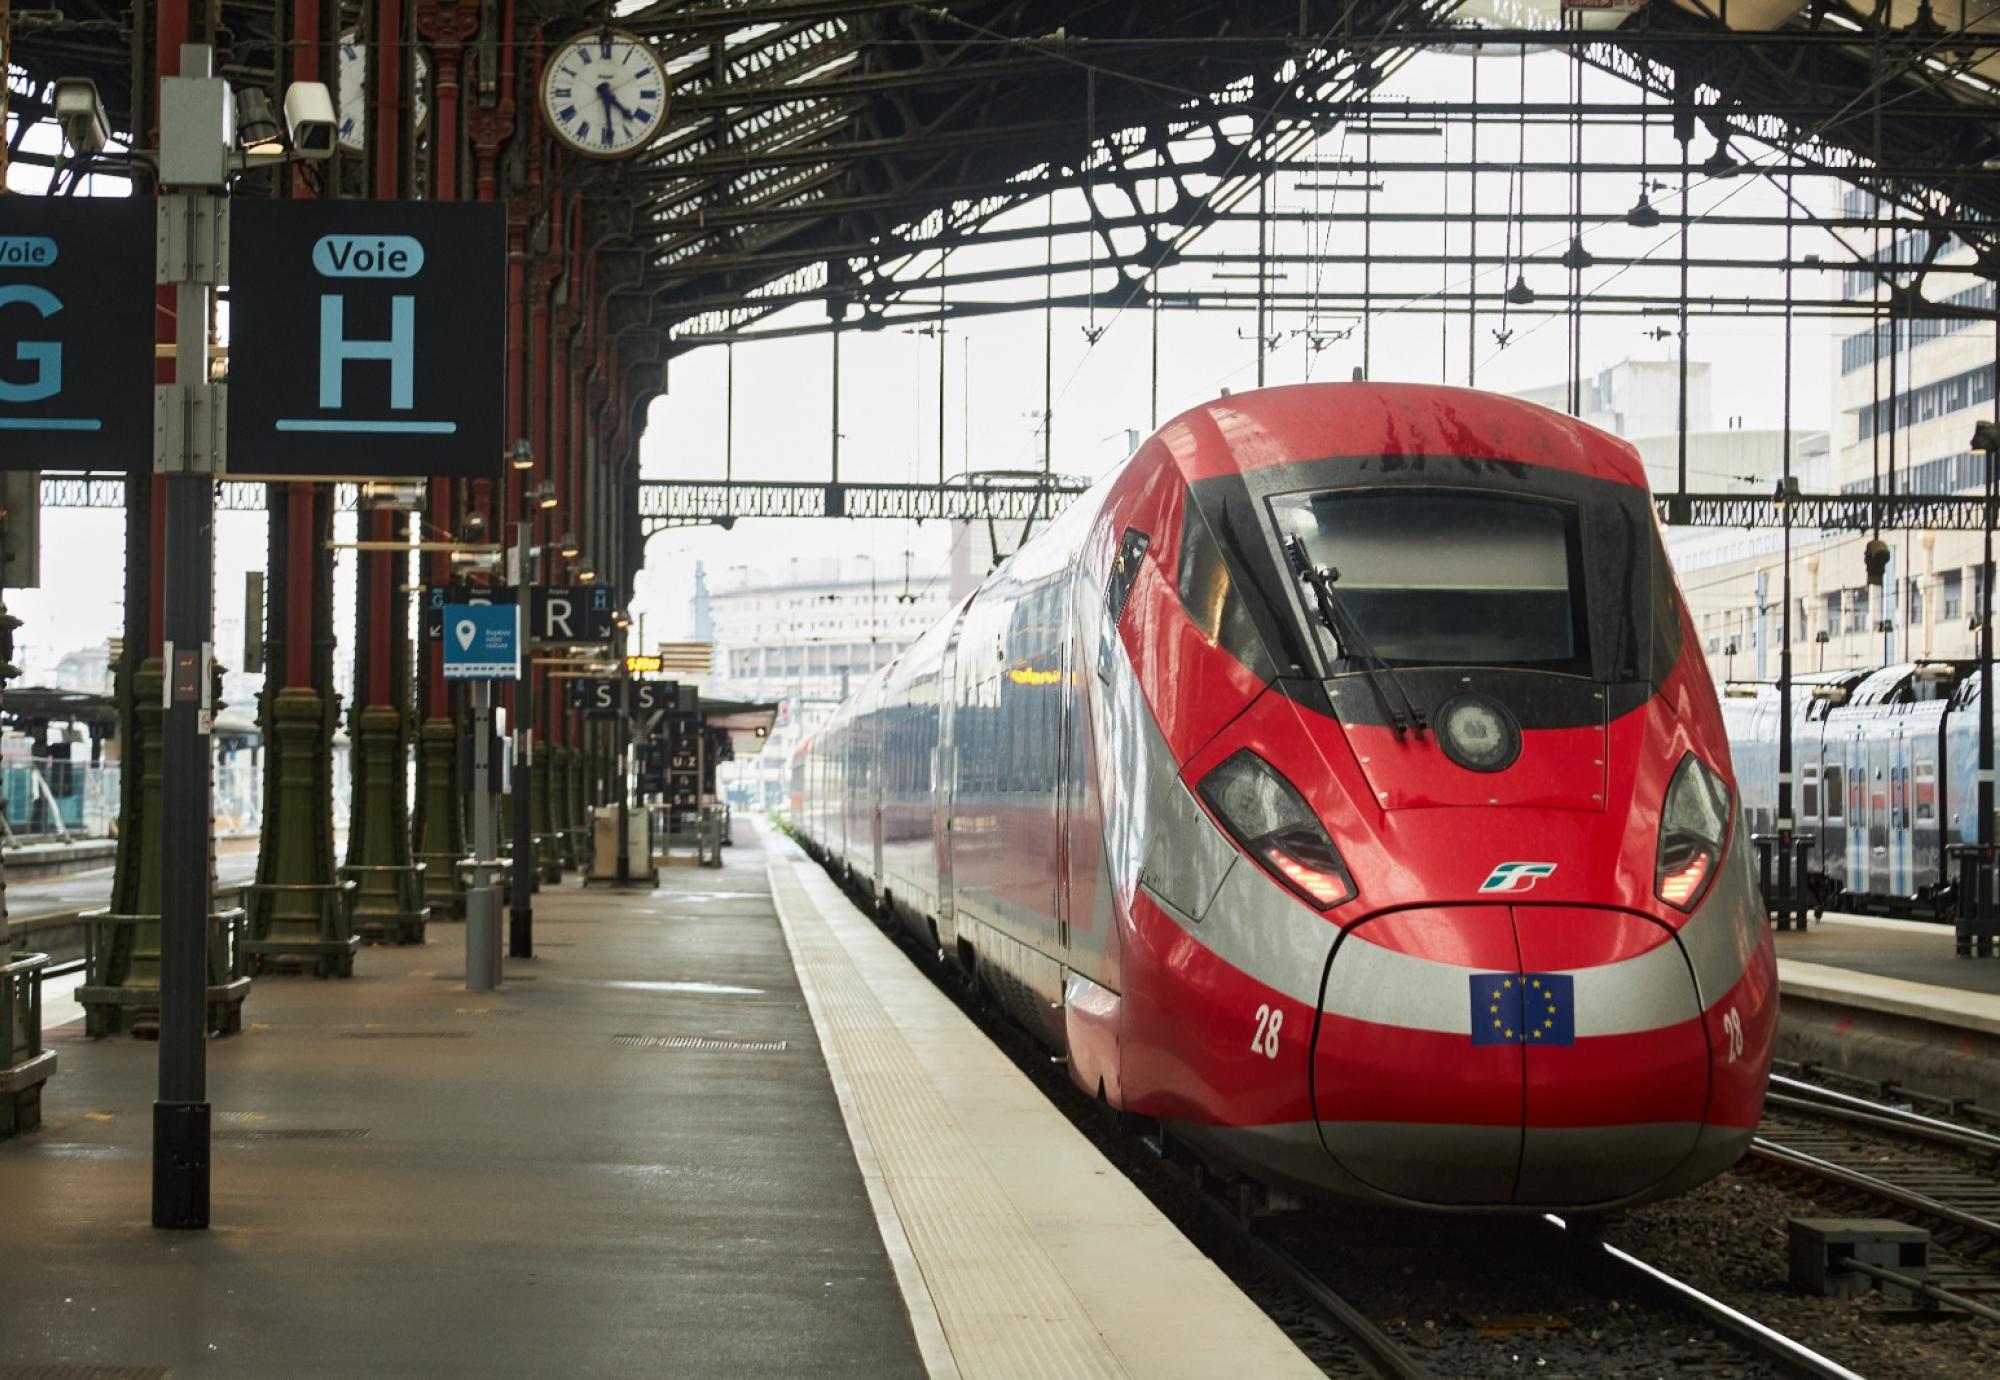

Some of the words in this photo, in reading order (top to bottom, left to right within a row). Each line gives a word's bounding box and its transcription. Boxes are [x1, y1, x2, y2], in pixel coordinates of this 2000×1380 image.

[326, 240, 408, 272] Voie
[0, 284, 64, 402] G
[319, 294, 415, 409] H
[546, 598, 573, 637] R
[594, 594, 607, 609] H
[596, 685, 612, 708] S
[639, 685, 655, 708] S
[1251, 1003, 1283, 1060] 28
[1723, 1006, 1744, 1064] 28
